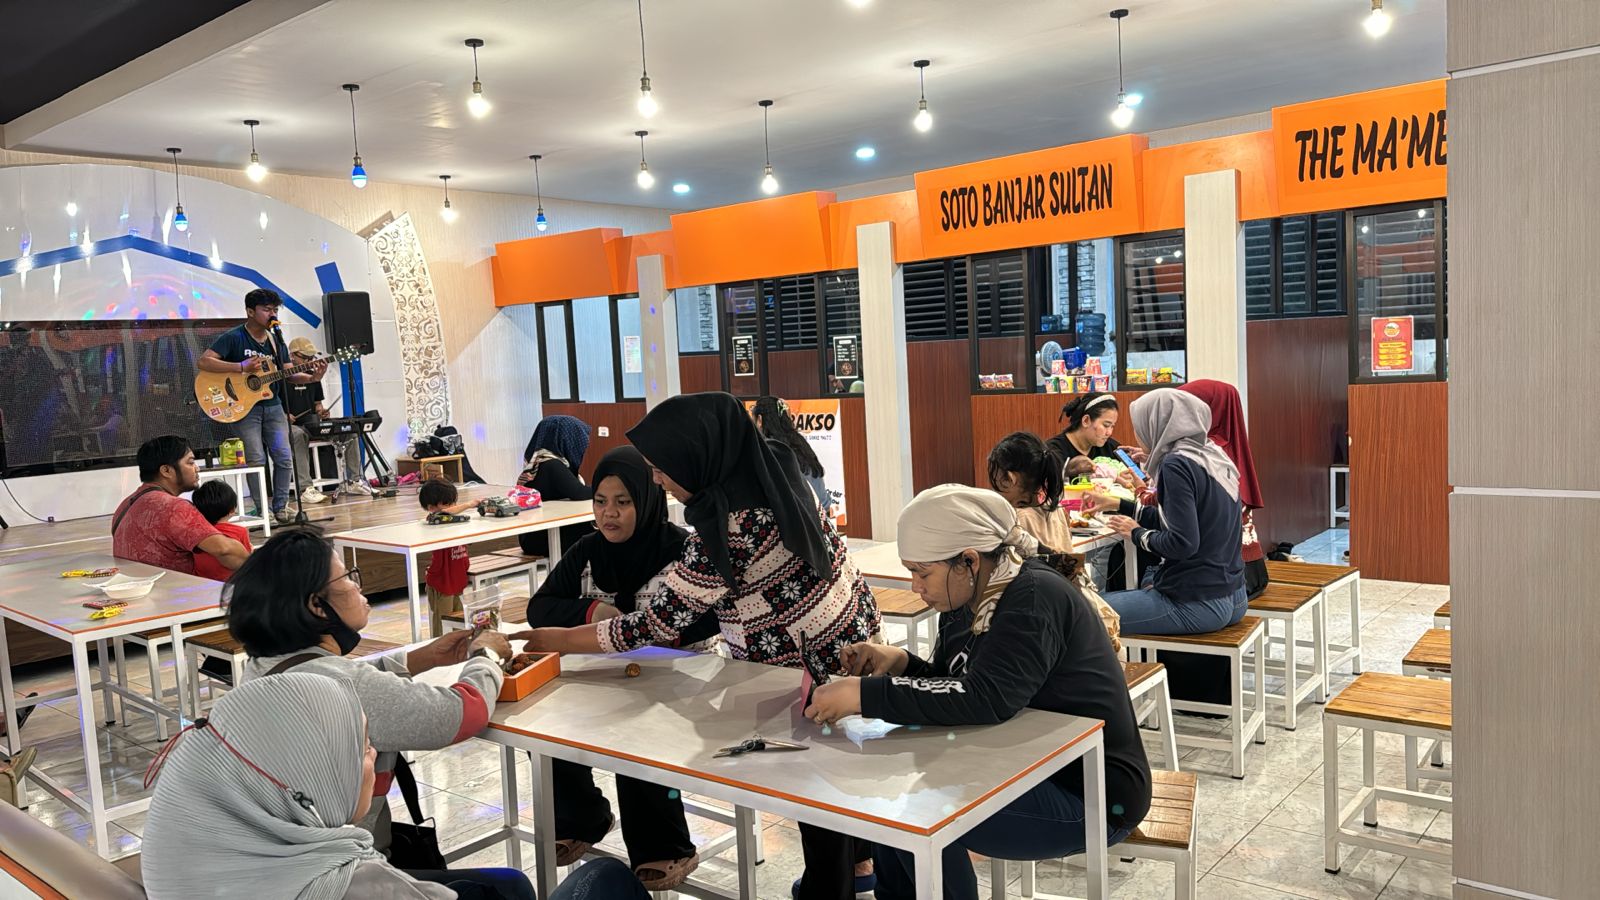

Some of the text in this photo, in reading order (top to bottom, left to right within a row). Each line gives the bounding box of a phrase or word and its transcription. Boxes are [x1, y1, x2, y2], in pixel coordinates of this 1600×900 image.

[1295, 125, 1346, 182] THE
[940, 163, 1113, 232] SOTO BANJAR SULTAN
[244, 349, 274, 361] Rebo
